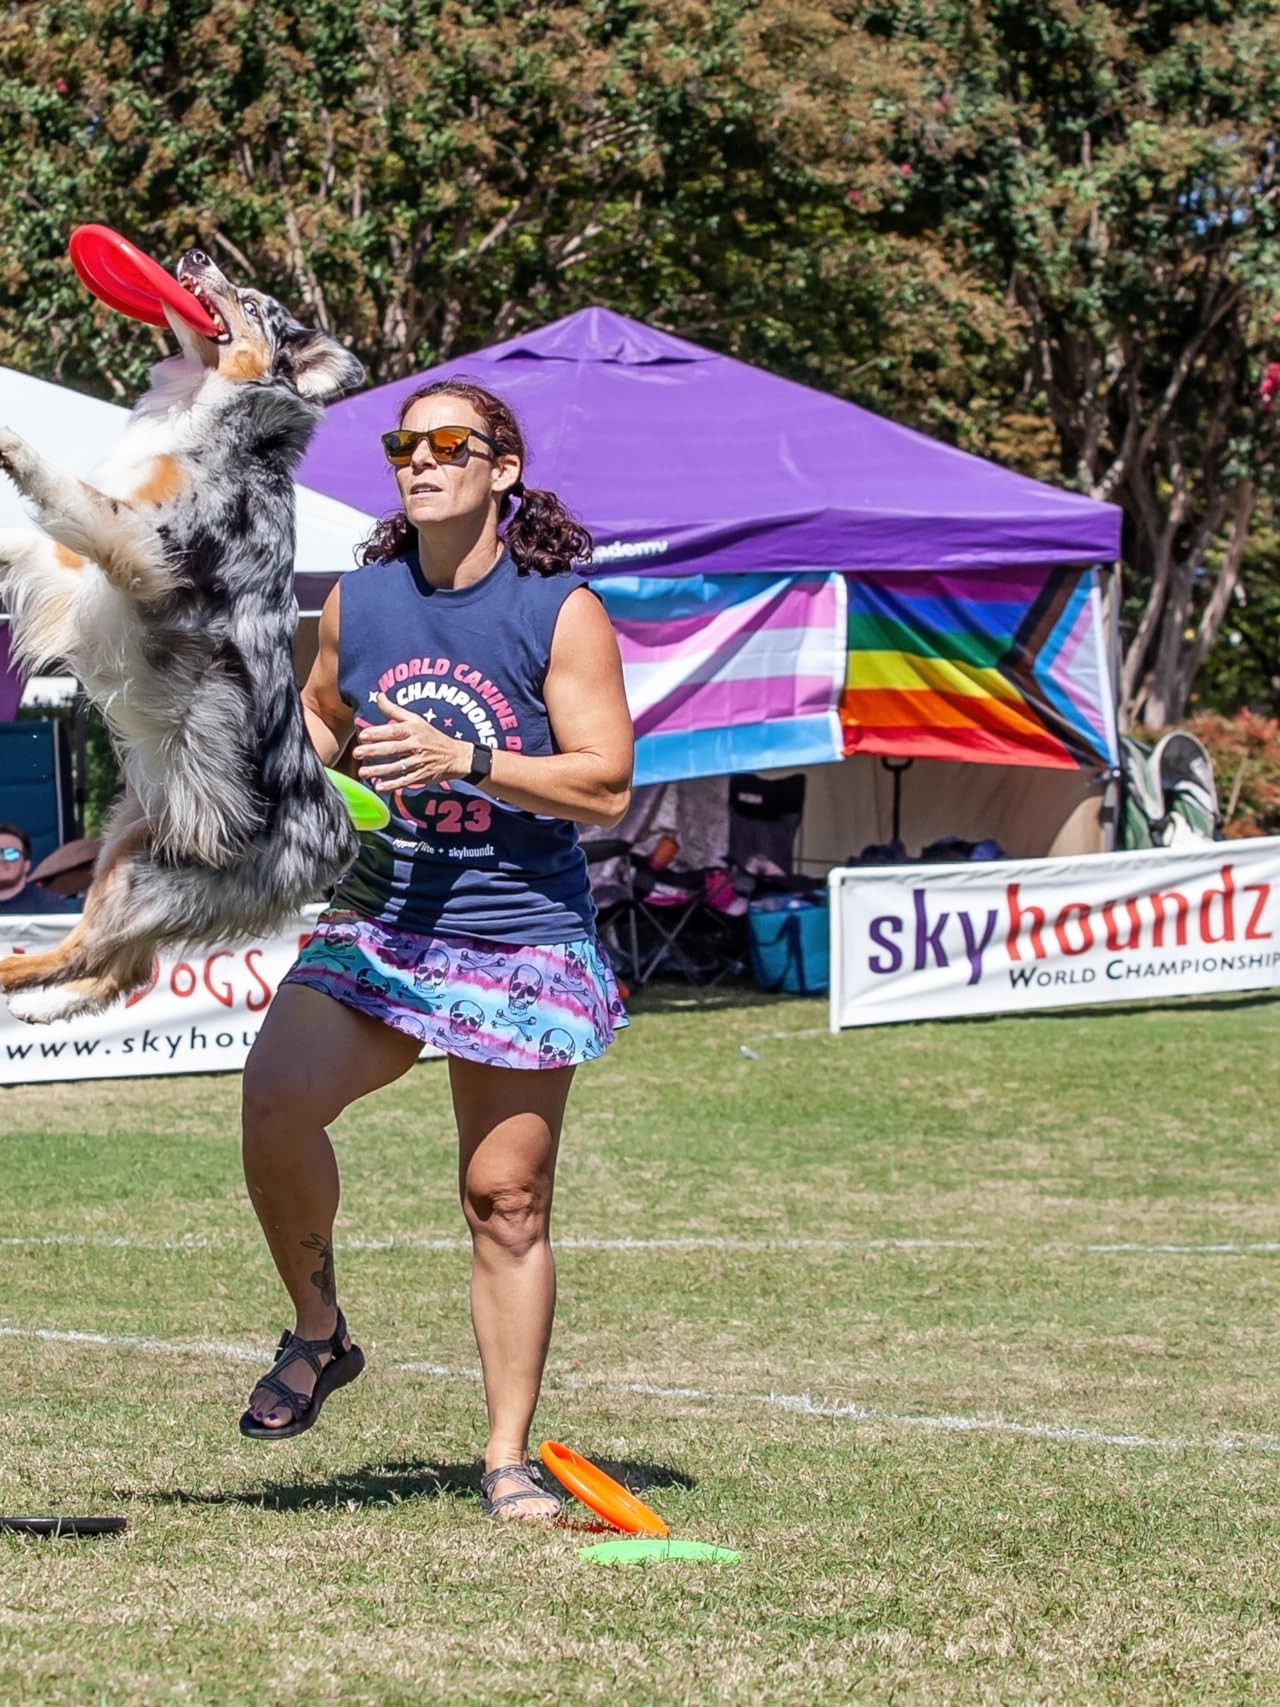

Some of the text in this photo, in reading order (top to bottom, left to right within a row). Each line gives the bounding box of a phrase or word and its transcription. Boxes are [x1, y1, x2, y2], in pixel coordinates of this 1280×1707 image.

[378, 657, 522, 754] WORLD CANINE D
[396, 681, 499, 750] CHAMPIONS
[448, 843, 495, 860] skyhoundz
[868, 863, 1273, 985] skyhoundz
[1009, 951, 1280, 990] WORLD CHAMPIONSHIP
